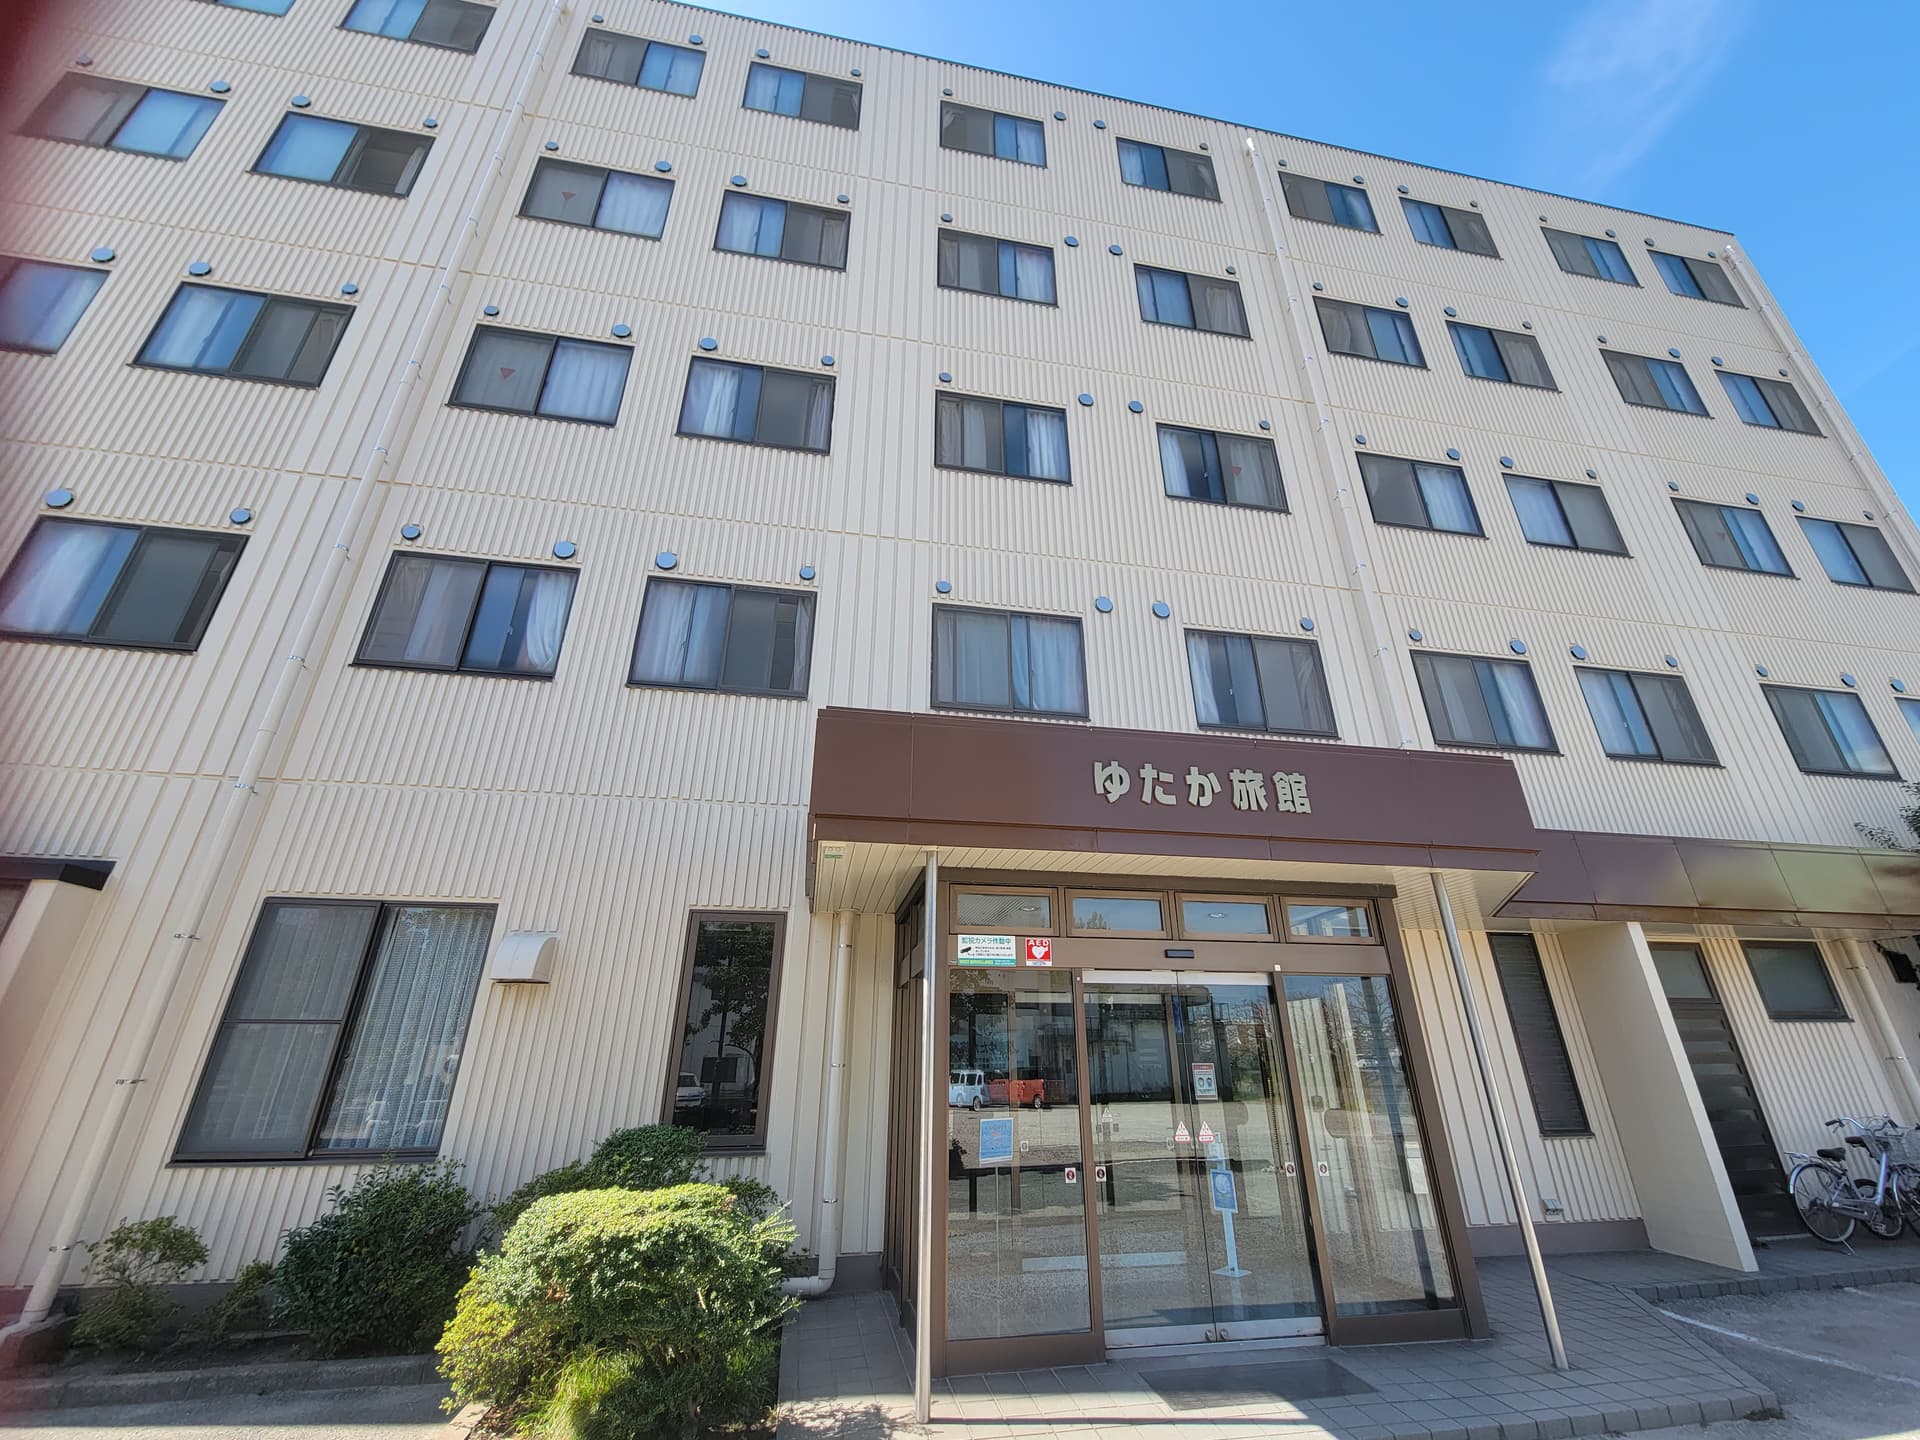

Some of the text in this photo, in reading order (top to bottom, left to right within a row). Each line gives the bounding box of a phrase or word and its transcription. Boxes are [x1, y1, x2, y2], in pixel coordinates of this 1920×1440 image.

[1094, 760, 1312, 814] ゆたか旅館
[961, 936, 1012, 945] 監視カメラ作動中
